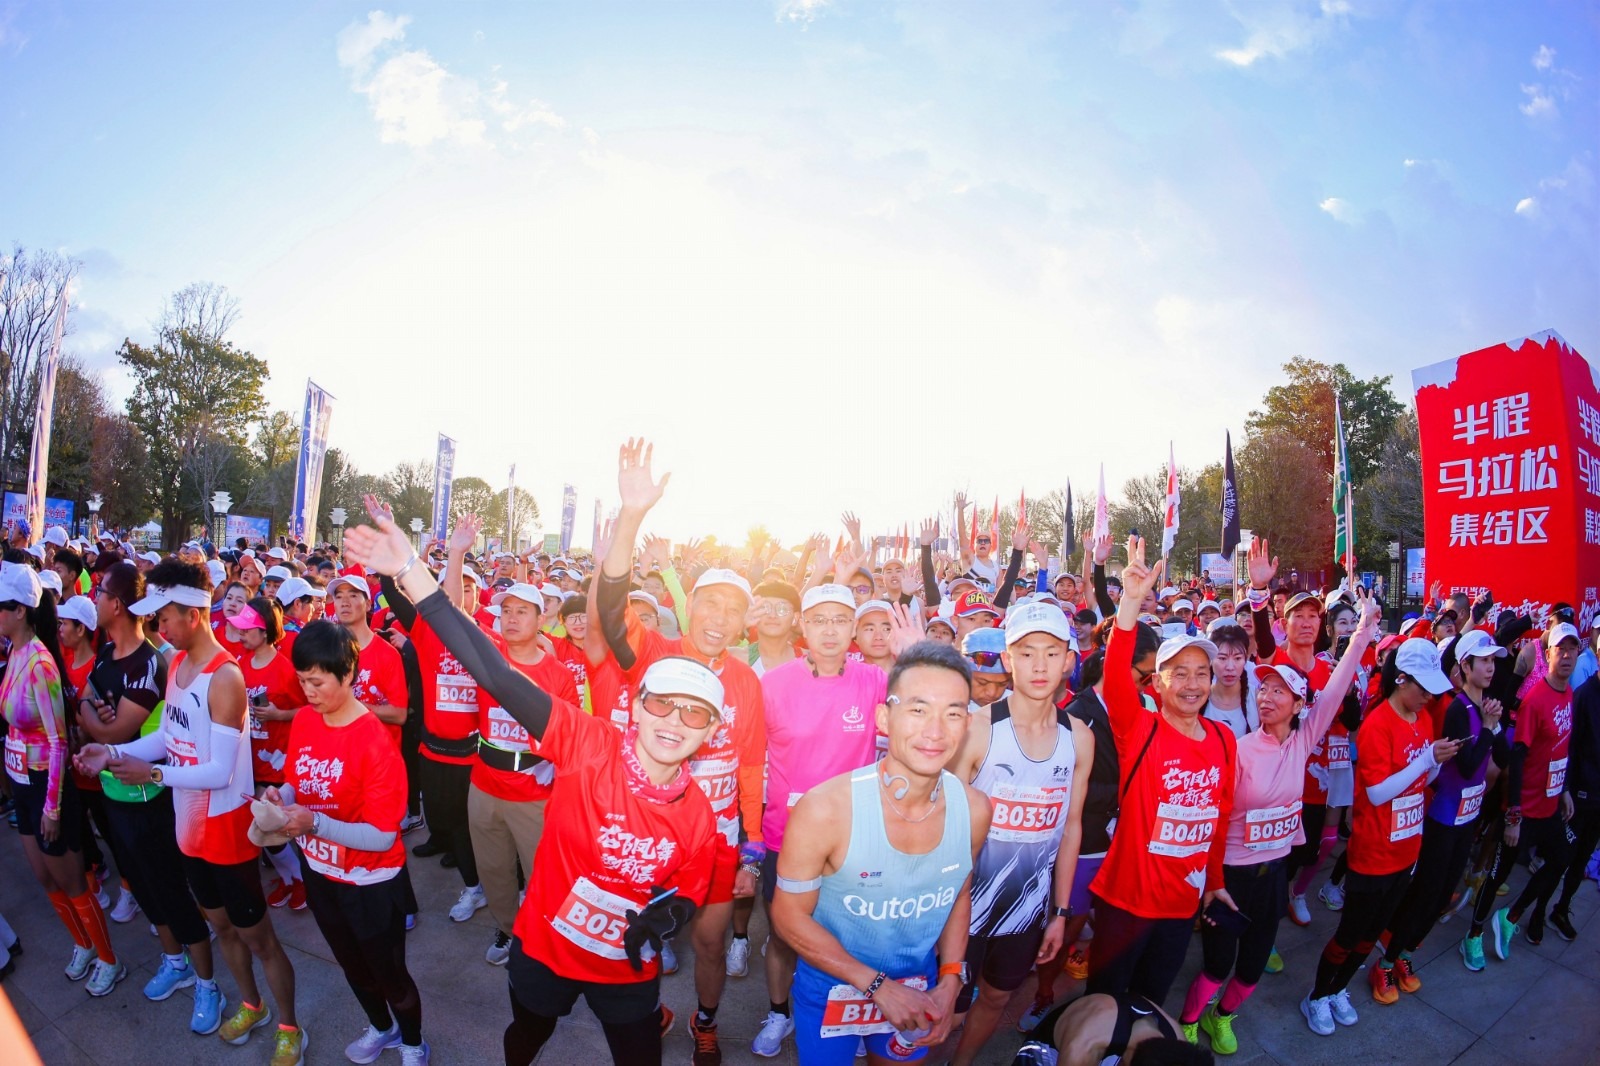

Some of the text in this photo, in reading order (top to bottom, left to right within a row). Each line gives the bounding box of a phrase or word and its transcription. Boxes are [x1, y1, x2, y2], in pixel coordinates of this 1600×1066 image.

[1453, 391, 1530, 445] 半程
[1437, 444, 1558, 500] 马拉松
[1448, 506, 1550, 547] 集结区
[992, 803, 1058, 828] B0330
[1160, 821, 1213, 843] B0419
[1250, 814, 1299, 841] B0850
[566, 901, 630, 945] B05
